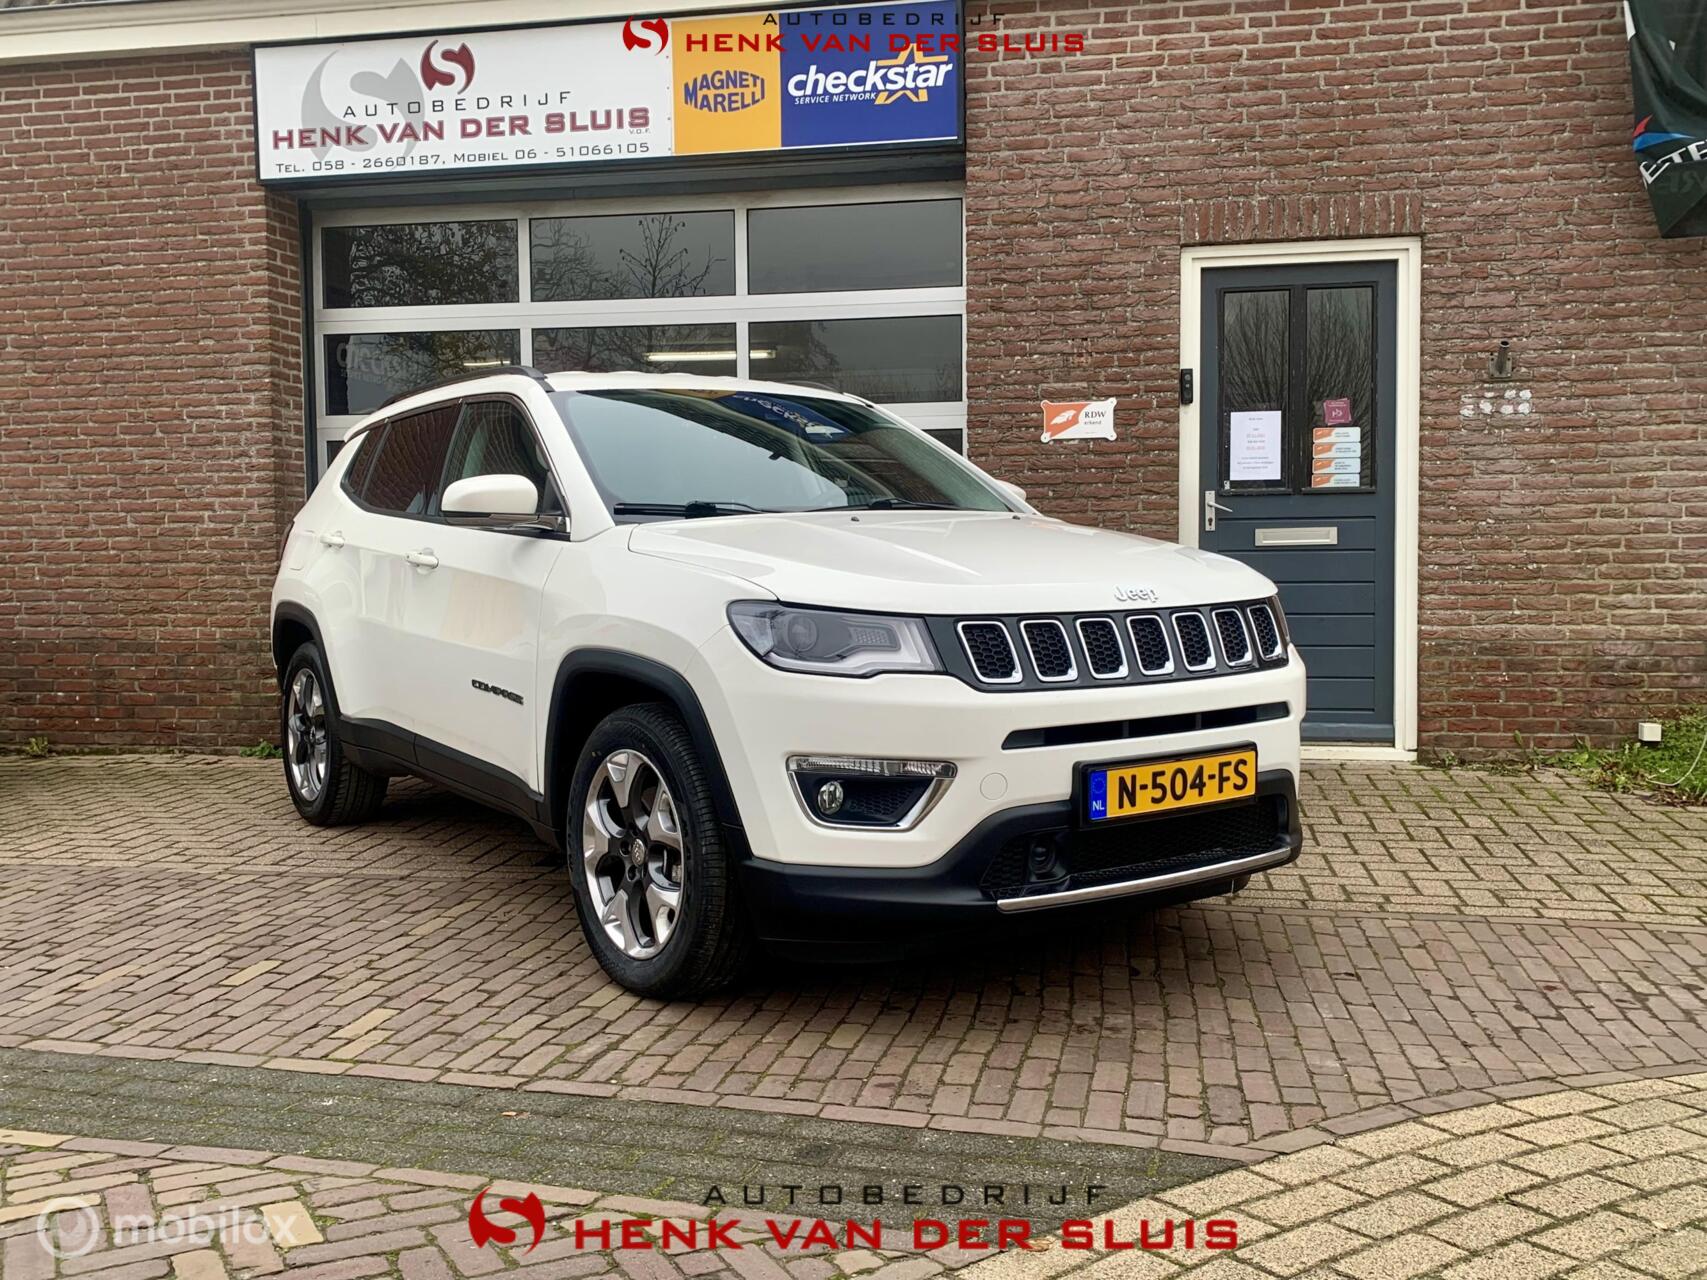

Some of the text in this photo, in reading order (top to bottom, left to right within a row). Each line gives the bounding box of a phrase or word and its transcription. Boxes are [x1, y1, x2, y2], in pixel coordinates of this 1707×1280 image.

[684, 70, 765, 98] MAGNETI
[787, 60, 953, 97] checkstar
[343, 91, 572, 119] AUTOBEDRIJF
[684, 86, 765, 112] MARELLI
[795, 92, 877, 105] SERVICE NETWORK
[272, 107, 650, 150] HENK VAN DER SLUIS
[312, 160, 344, 171] 058
[363, 154, 446, 169] 2660187,
[515, 149, 537, 160] 06
[556, 142, 650, 157] 51066105
[1084, 410, 1106, 419] RDW
[1113, 584, 1159, 604] Jeep
[1118, 758, 1249, 810] N-504-FS
[1092, 800, 1105, 811] NL
